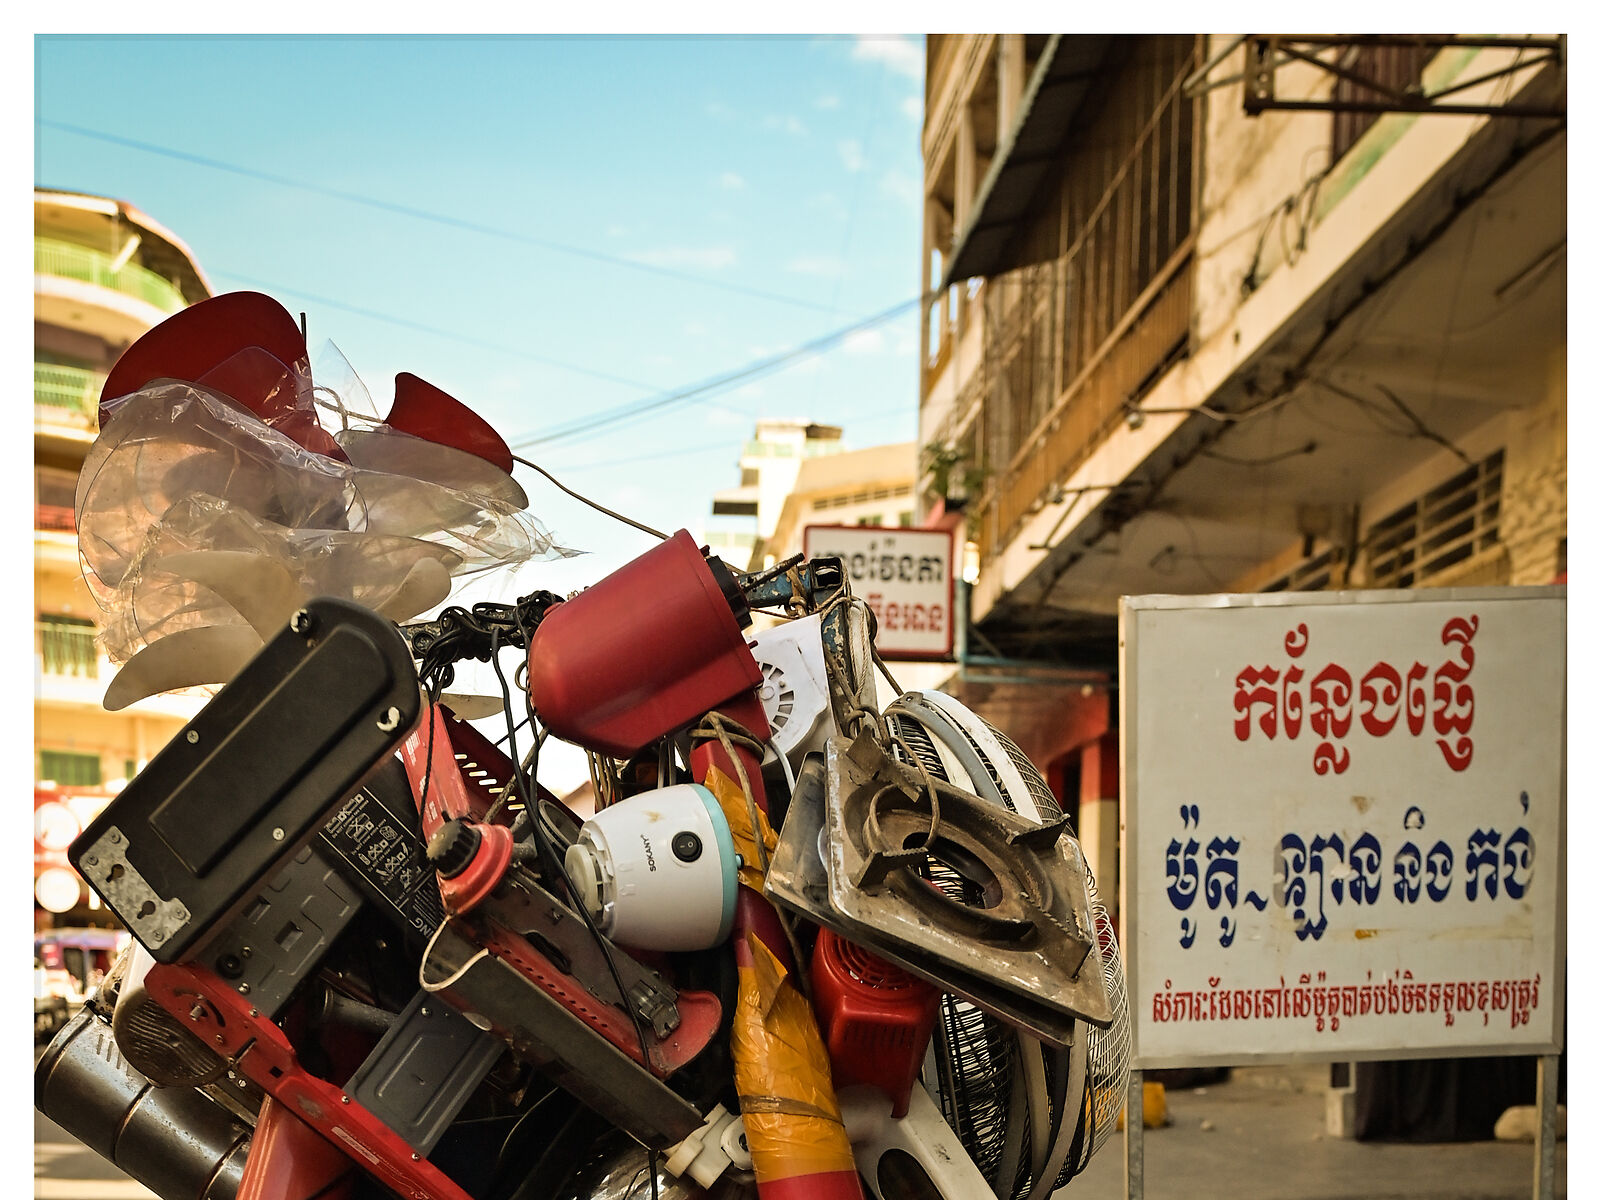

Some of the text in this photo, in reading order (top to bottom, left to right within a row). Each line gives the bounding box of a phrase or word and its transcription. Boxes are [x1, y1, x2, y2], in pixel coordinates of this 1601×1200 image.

[1233, 614, 1479, 775] កន្លែងផ្ញើ
[641, 836, 657, 872] SOKANY
